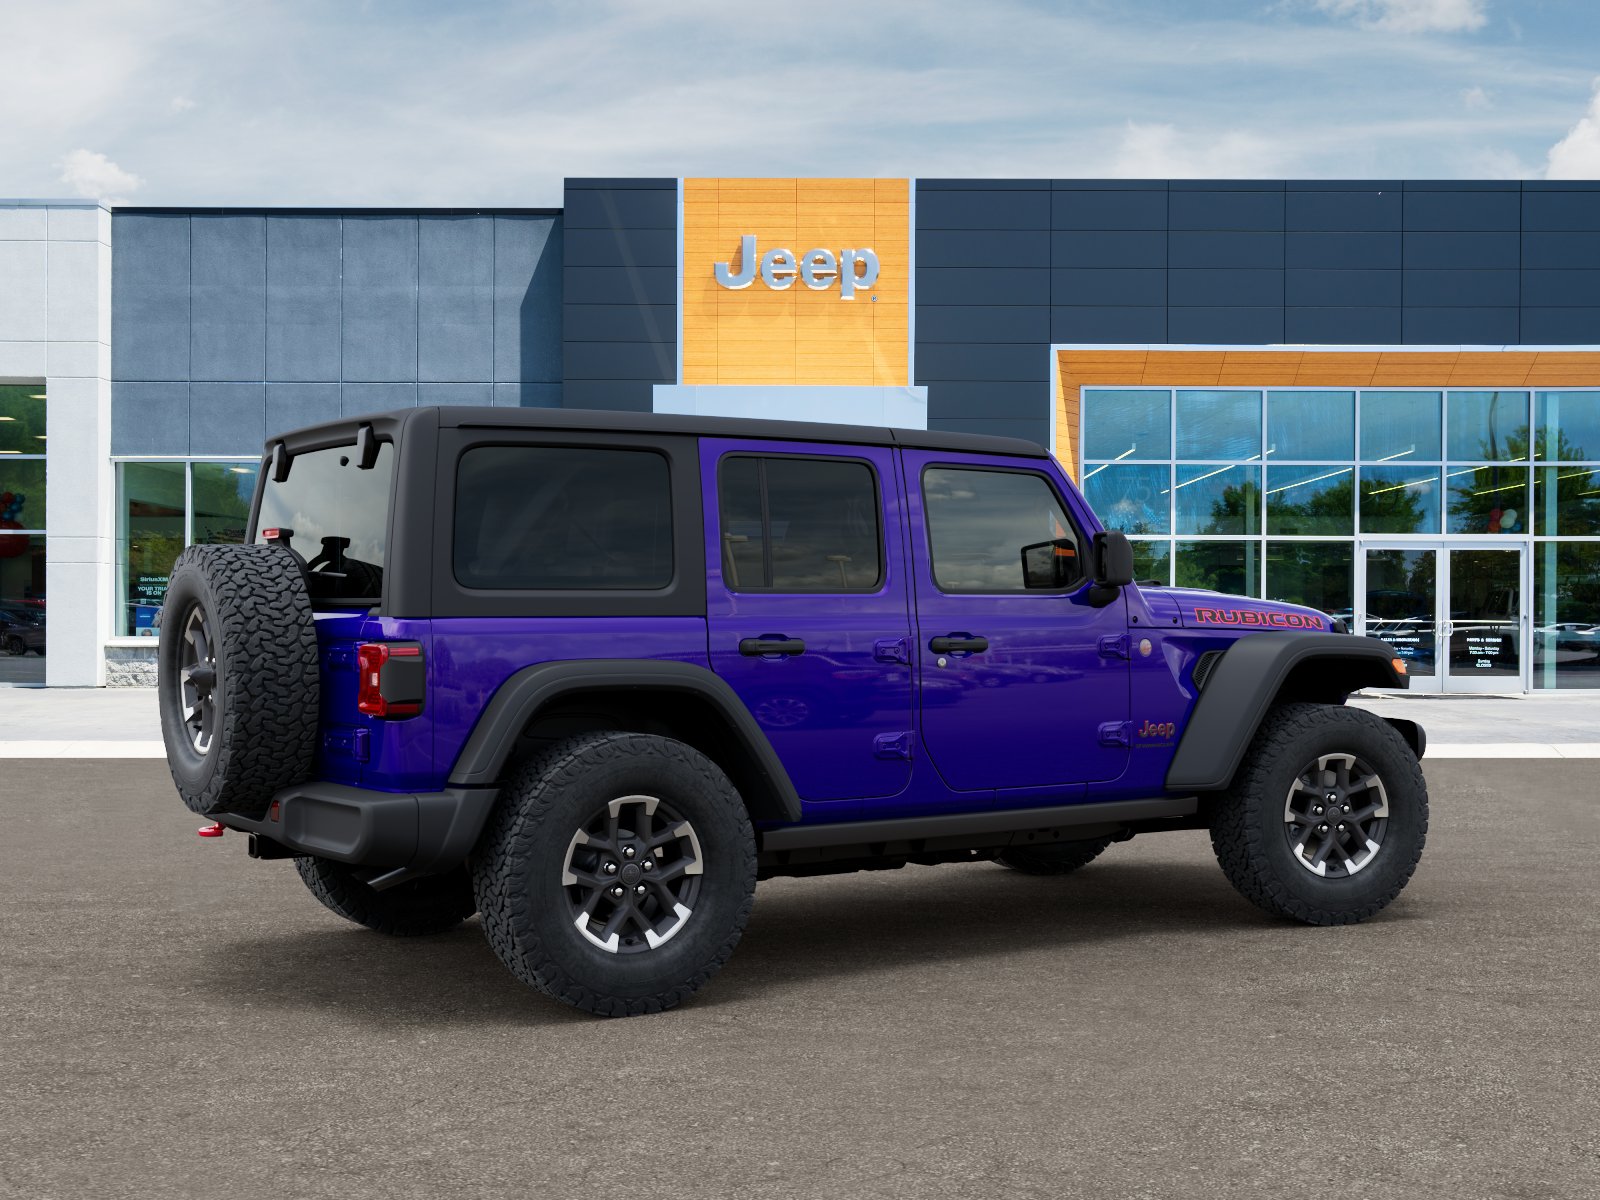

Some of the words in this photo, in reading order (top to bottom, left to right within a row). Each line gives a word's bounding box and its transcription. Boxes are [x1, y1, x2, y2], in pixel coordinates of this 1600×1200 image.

[714, 234, 880, 300] Jeep
[1194, 607, 1324, 630] RUBICON
[1138, 720, 1176, 740] Jeep
